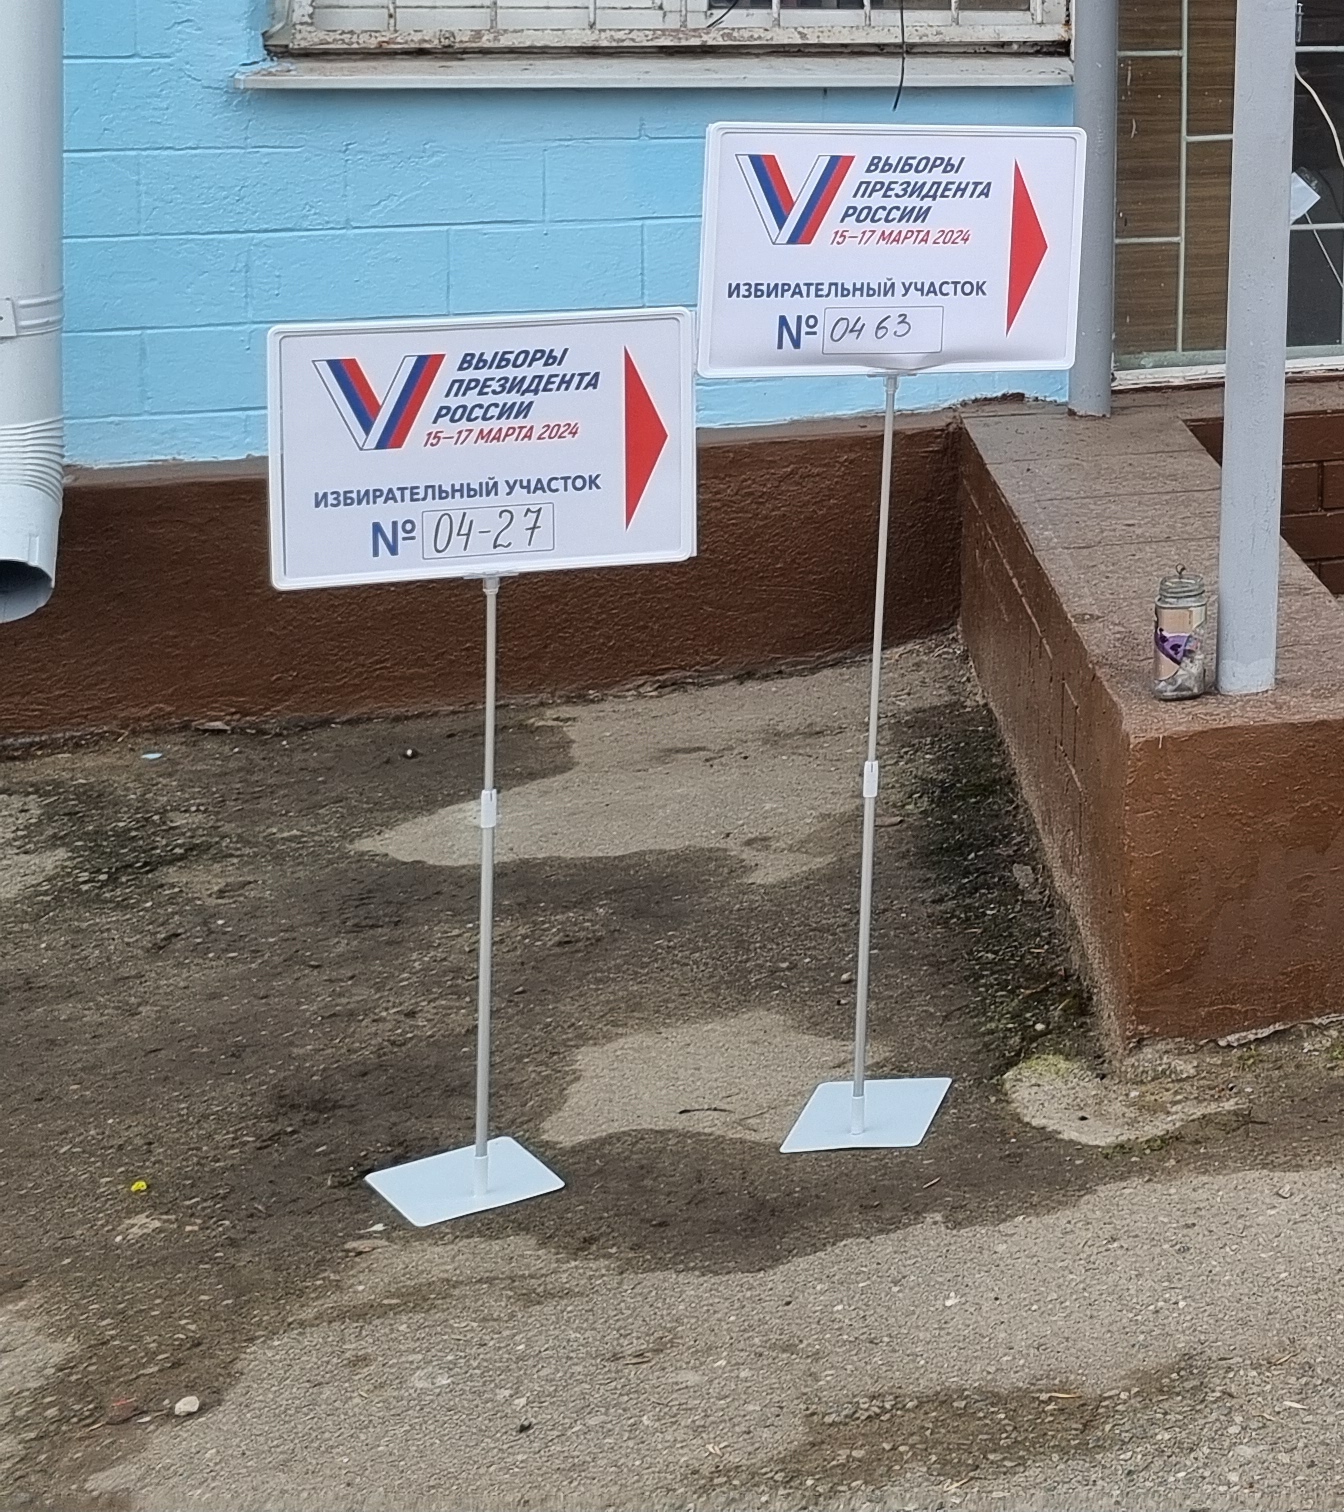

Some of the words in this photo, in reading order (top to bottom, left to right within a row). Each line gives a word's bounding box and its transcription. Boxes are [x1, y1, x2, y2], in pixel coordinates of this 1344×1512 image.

[864, 156, 965, 174] ВЫБОРЫ
[852, 181, 992, 201] ПРЕЗИДЕНТА
[839, 205, 933, 224] РОССИИ
[876, 229, 931, 245] МАРТА
[932, 229, 971, 245] 2024
[727, 277, 896, 299] ИЗБИРАТЕЛЬНЫЙ
[900, 281, 988, 297] УЧАСТОК
[776, 314, 819, 350] №
[456, 348, 569, 372] ВЫБОРЫ
[444, 371, 600, 398] ПРЕЗИДЕНТА
[432, 401, 534, 424] РОССИИ
[474, 425, 533, 444] МАРТА
[536, 422, 579, 441] 2024
[314, 477, 499, 508] ИЗБИРАТЕЛЬНЫЙ
[505, 474, 602, 496] УЧАСТОК
[371, 519, 417, 557] №
[433, 507, 543, 553] 04-27
